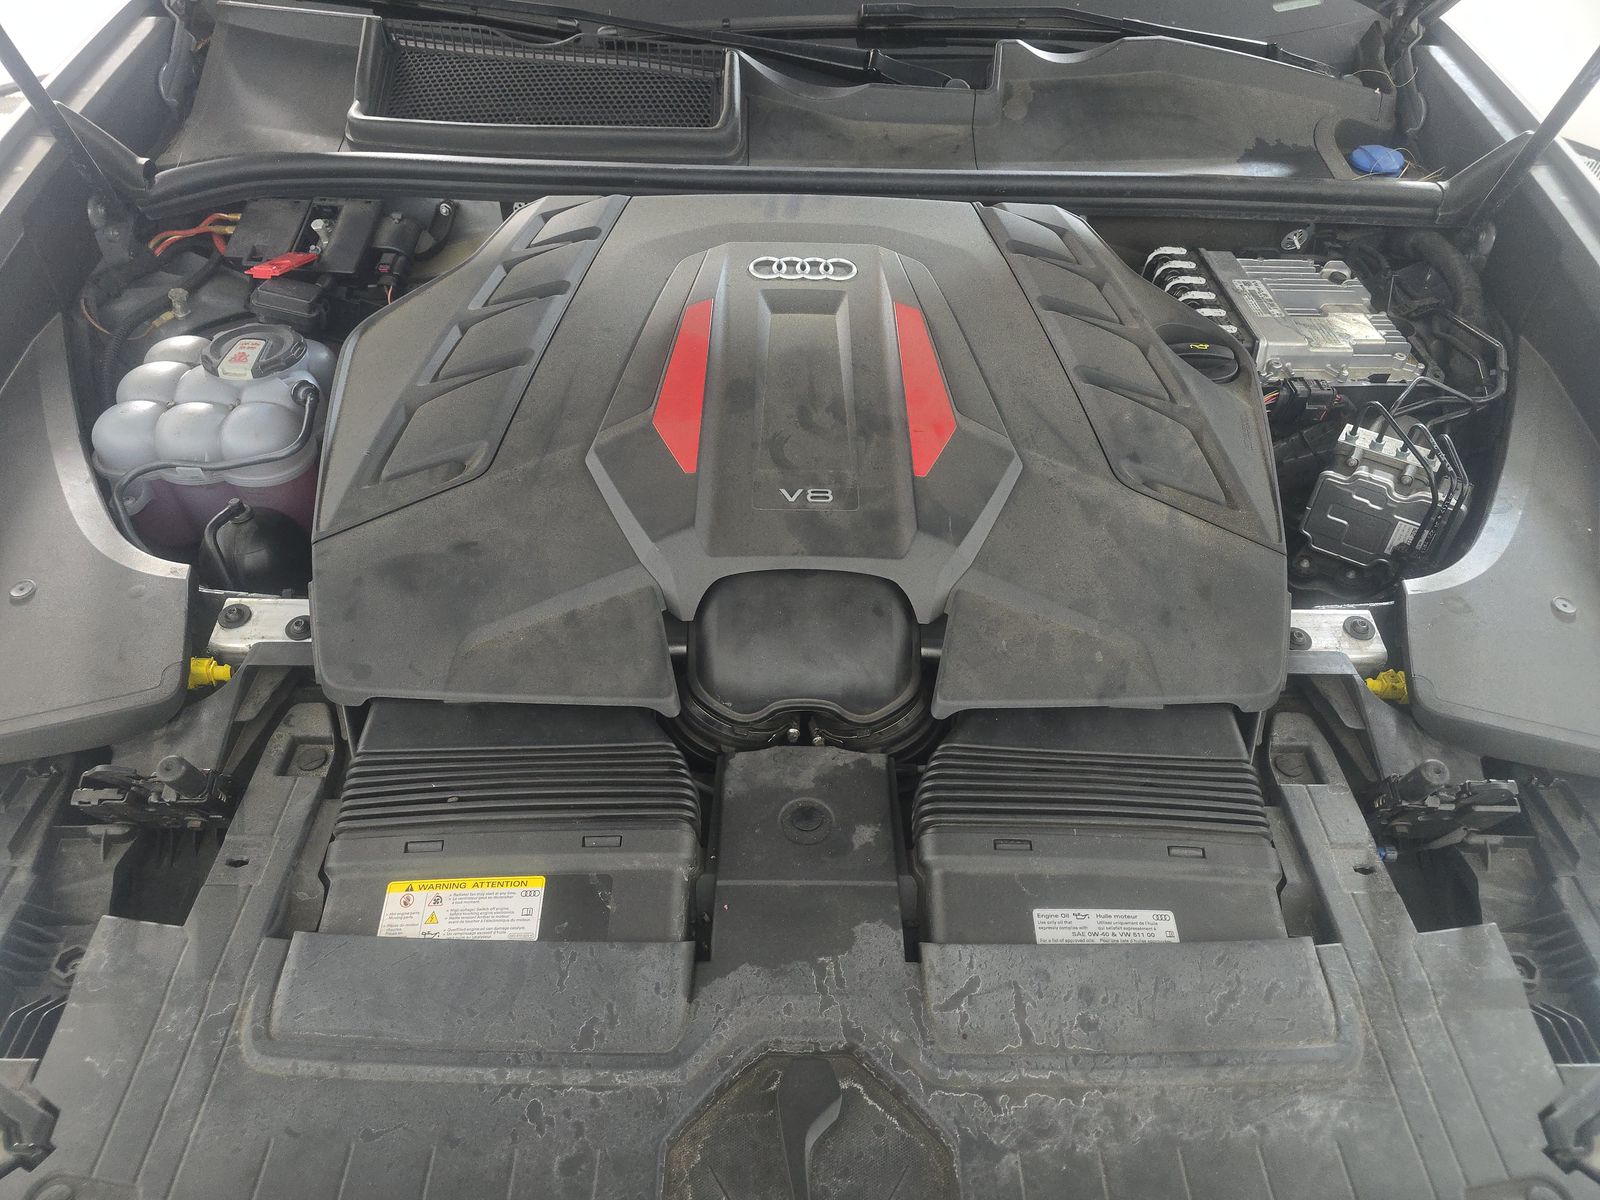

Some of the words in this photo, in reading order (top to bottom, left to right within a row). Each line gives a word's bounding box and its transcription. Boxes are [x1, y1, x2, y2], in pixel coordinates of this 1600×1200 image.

[779, 488, 834, 502] V8
[418, 882, 467, 891] WARNING
[472, 880, 529, 889] ATTENTION
